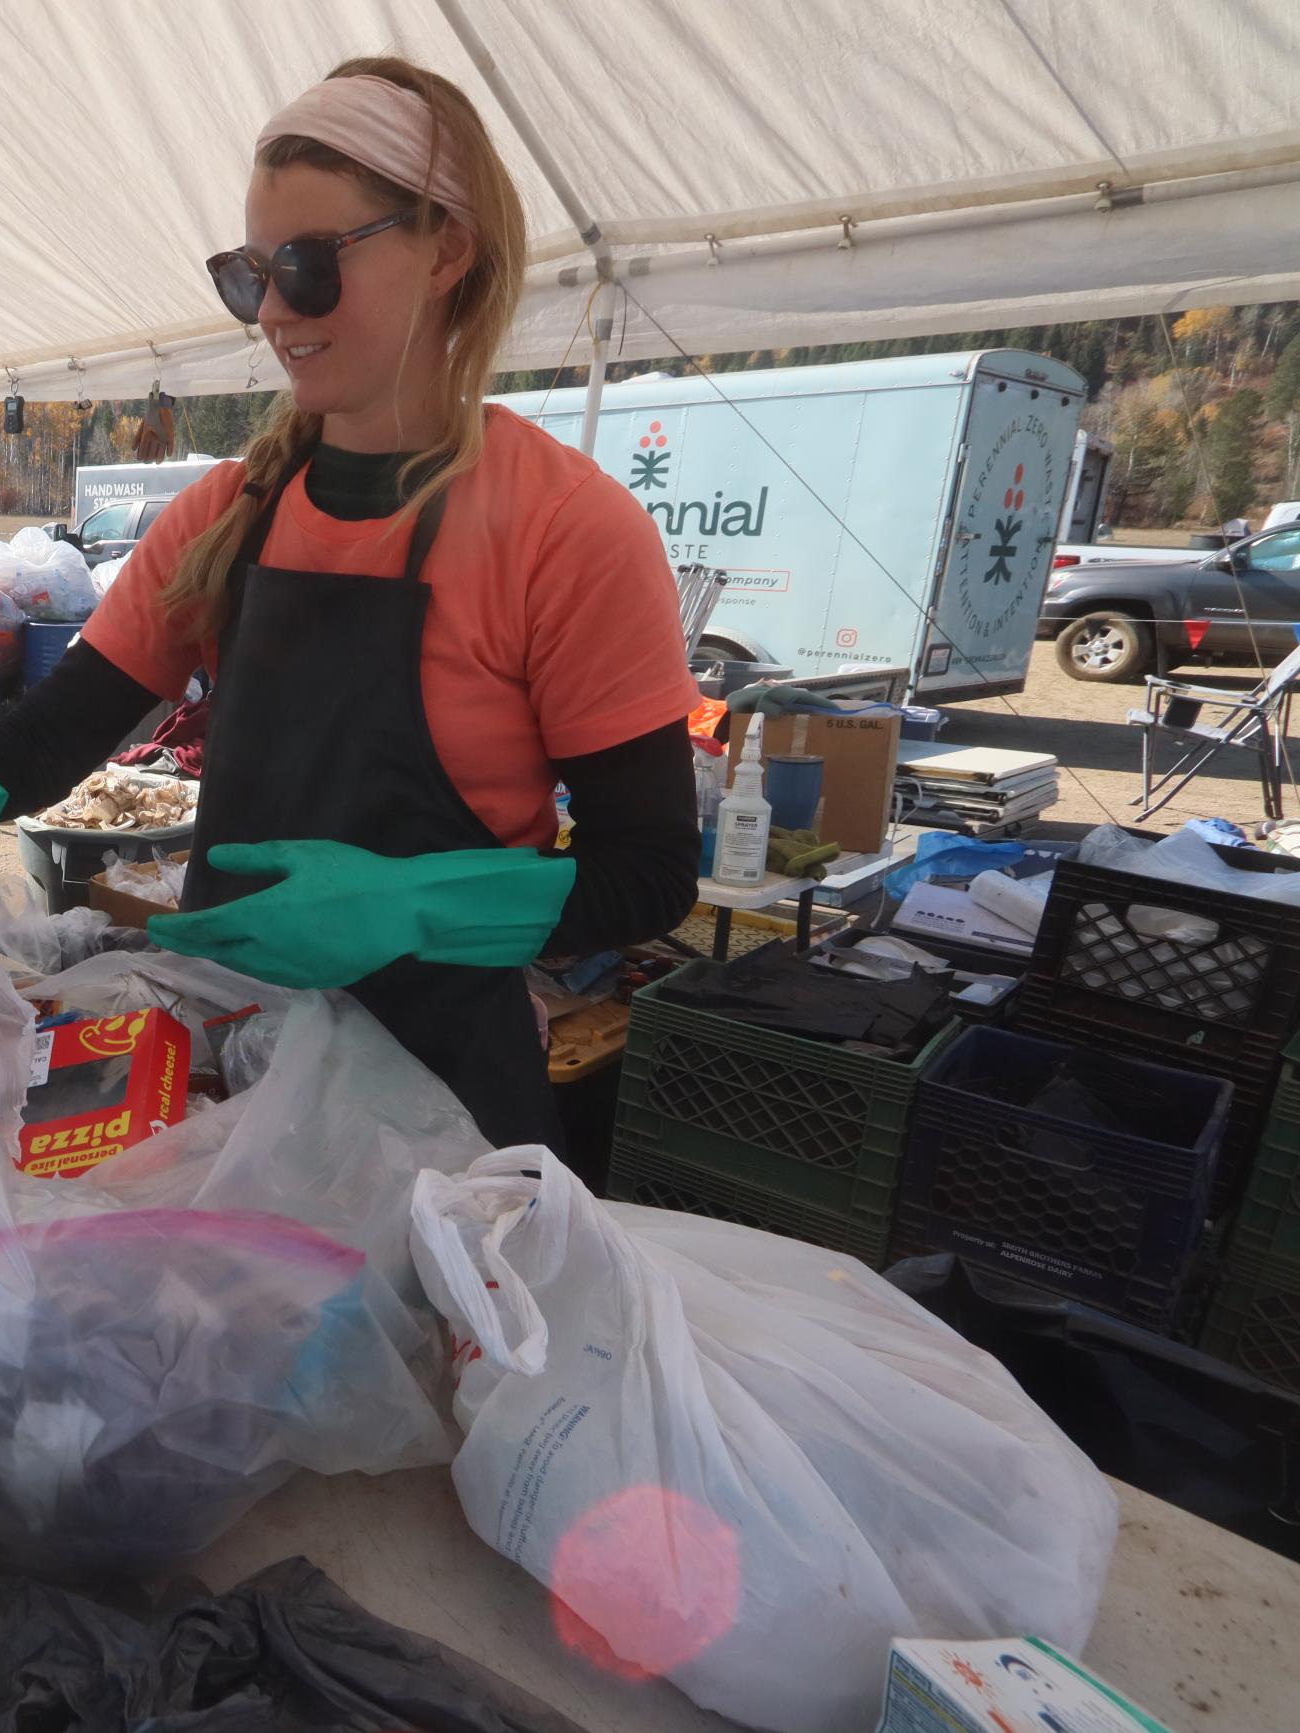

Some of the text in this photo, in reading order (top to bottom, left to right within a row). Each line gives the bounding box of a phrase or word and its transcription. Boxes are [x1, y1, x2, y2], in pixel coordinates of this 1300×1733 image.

[968, 418, 1023, 518] PERENNIAL
[1026, 415, 1048, 448] ZERO
[85, 483, 144, 497] HAND WASH
[646, 486, 769, 537] nnial
[669, 543, 709, 560] STE
[726, 576, 779, 588] ompany
[993, 540, 1045, 634] INTENTION
[720, 597, 756, 606] sponse
[797, 647, 892, 663] @perennialzero
[827, 719, 885, 730] 5 U.S. GAL.
[159, 1040, 177, 1121] real cheese!
[29, 1110, 132, 1155] pizza
[30, 1146, 119, 1172] personal size
[952, 1229, 997, 1249] Property of:
[1000, 1250, 1074, 1279] ALPENROSE DAIRY
[1001, 1241, 1103, 1280] SMITH BROTHERS FARMS
[539, 1433, 554, 1450] bag
[528, 1449, 542, 1473] away
[539, 1452, 555, 1475] avoid
[523, 1473, 536, 1497] from
[528, 1475, 545, 1512] danger
[511, 1498, 526, 1530] babies
[525, 1512, 534, 1525] of
[505, 1530, 516, 1553] and
